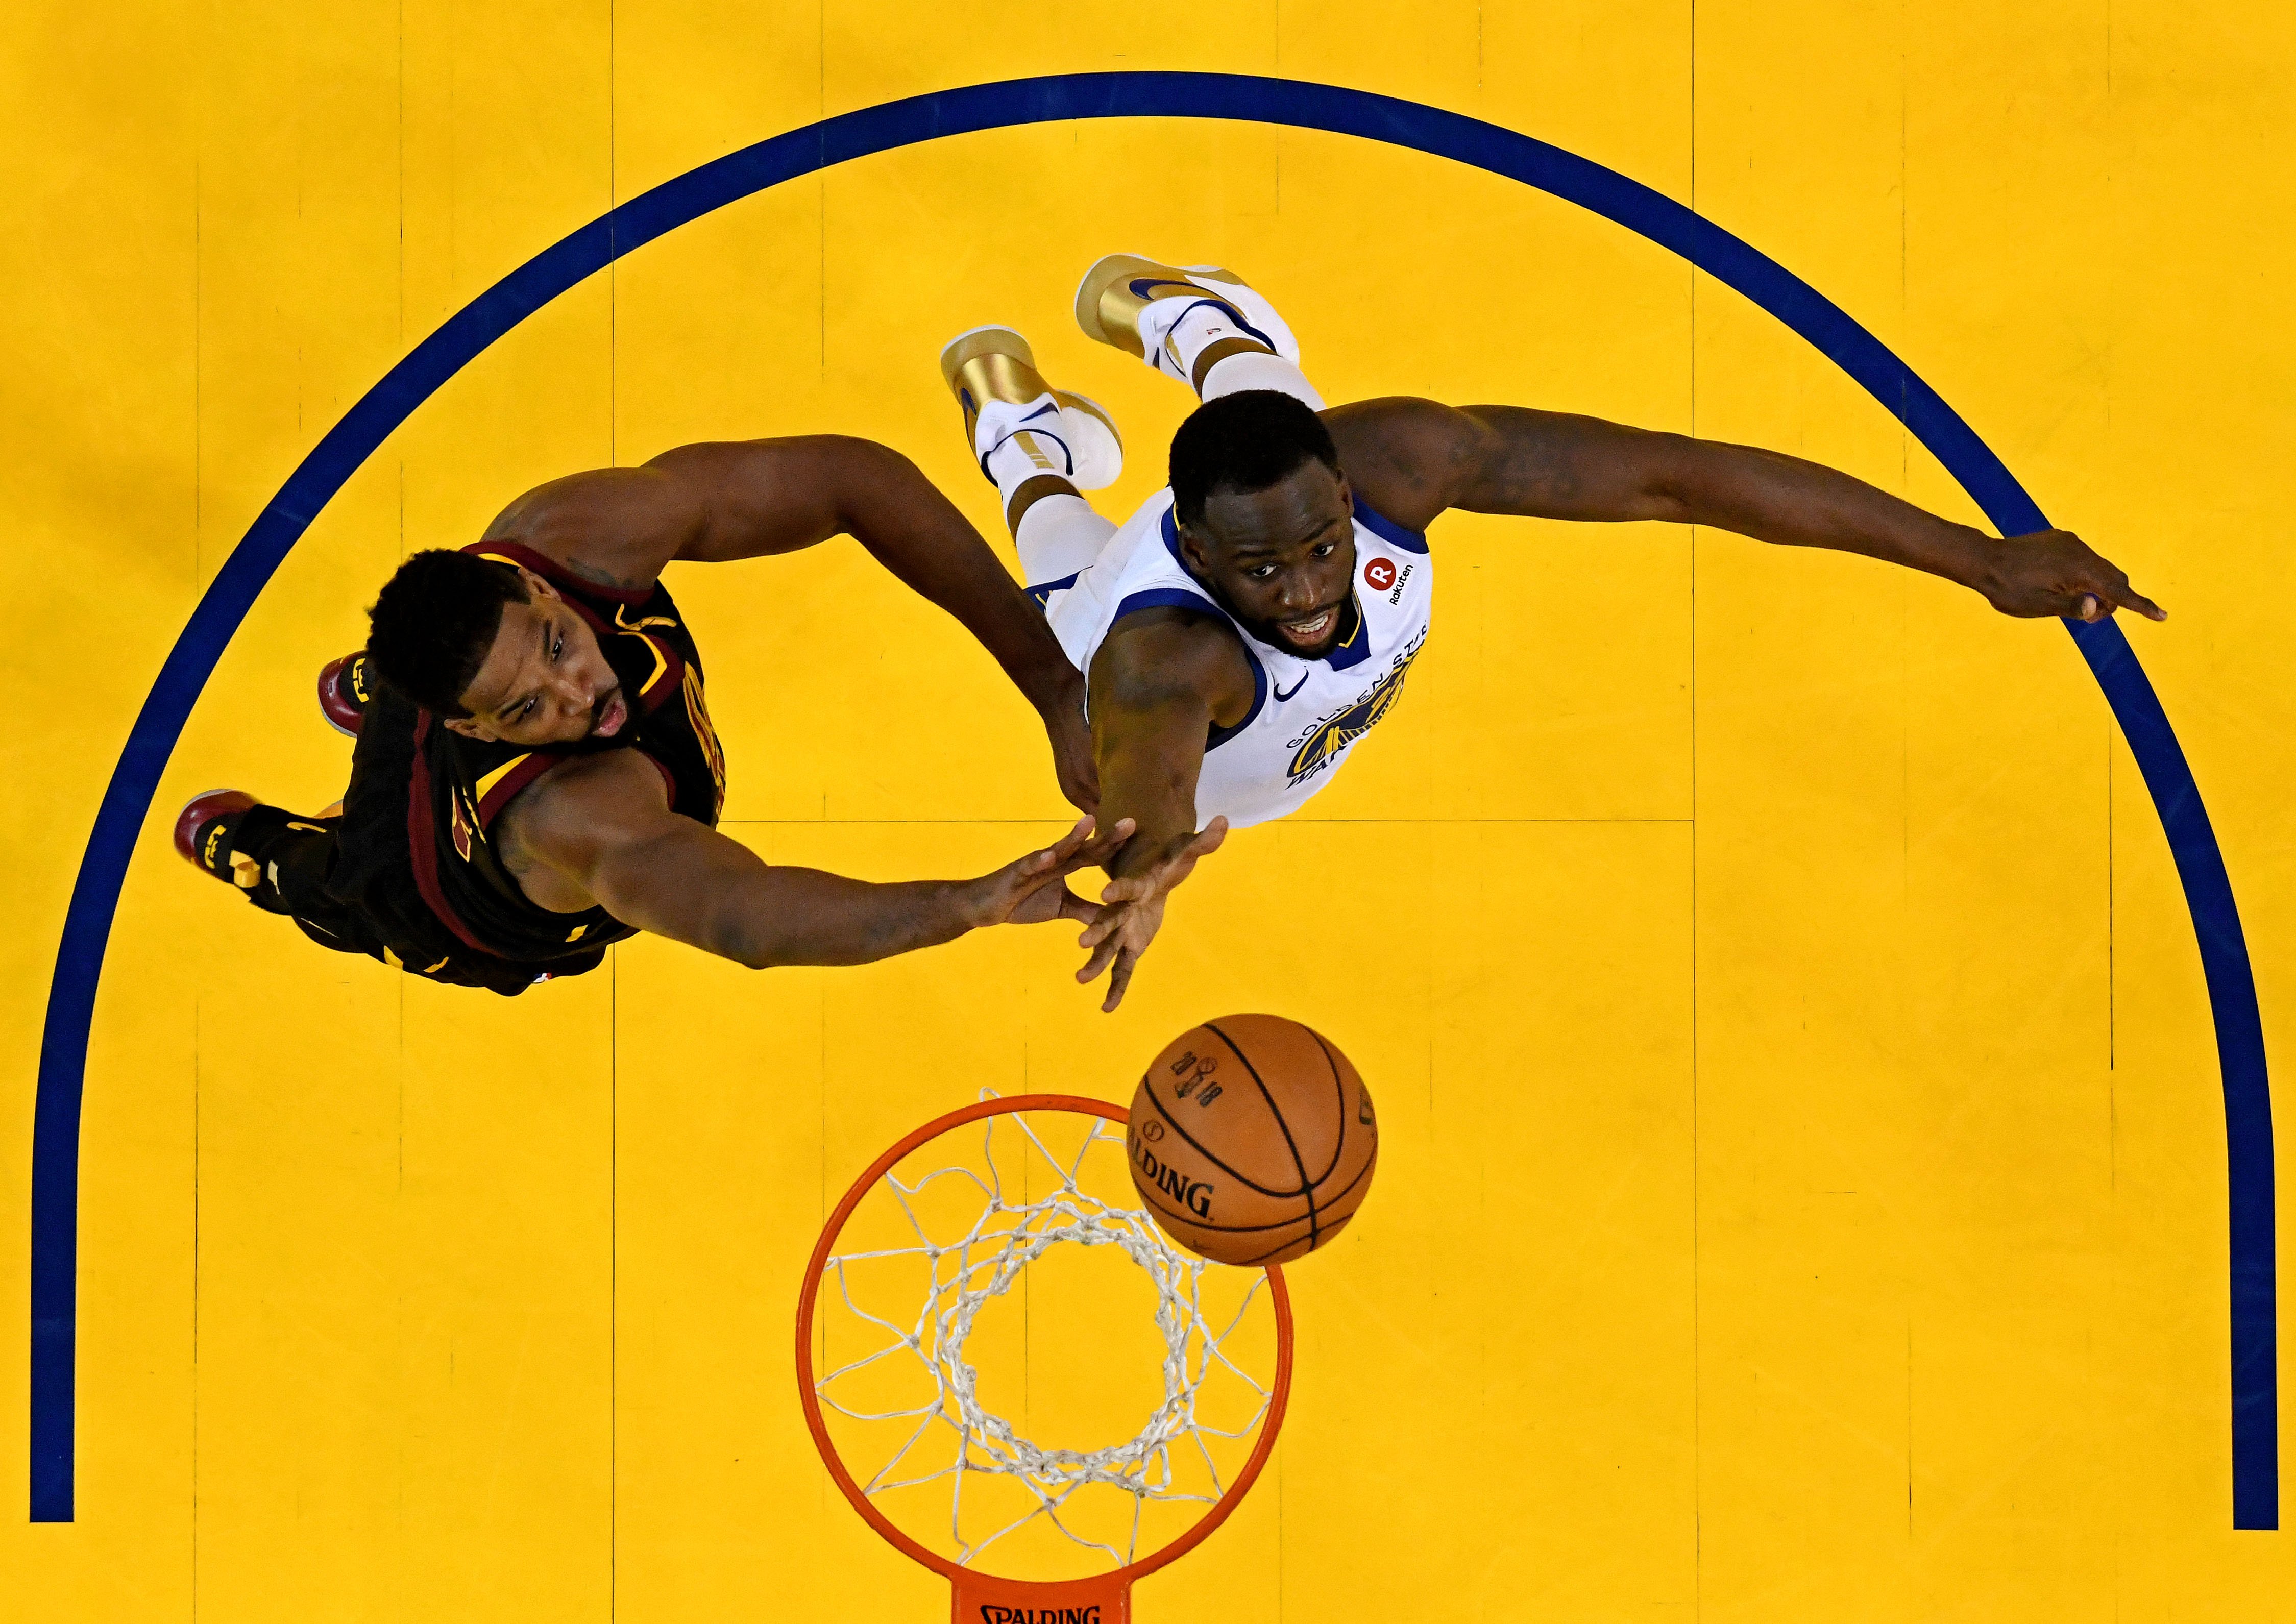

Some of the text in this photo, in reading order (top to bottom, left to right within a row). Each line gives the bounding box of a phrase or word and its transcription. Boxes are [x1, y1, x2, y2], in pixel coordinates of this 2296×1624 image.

[1369, 565, 1393, 584] R
[1389, 564, 1414, 605] Rakuten
[1286, 672, 1383, 749] GOLDEN
[1129, 1126, 1214, 1219] LDING
[980, 1604, 1100, 1624] SPALDING
